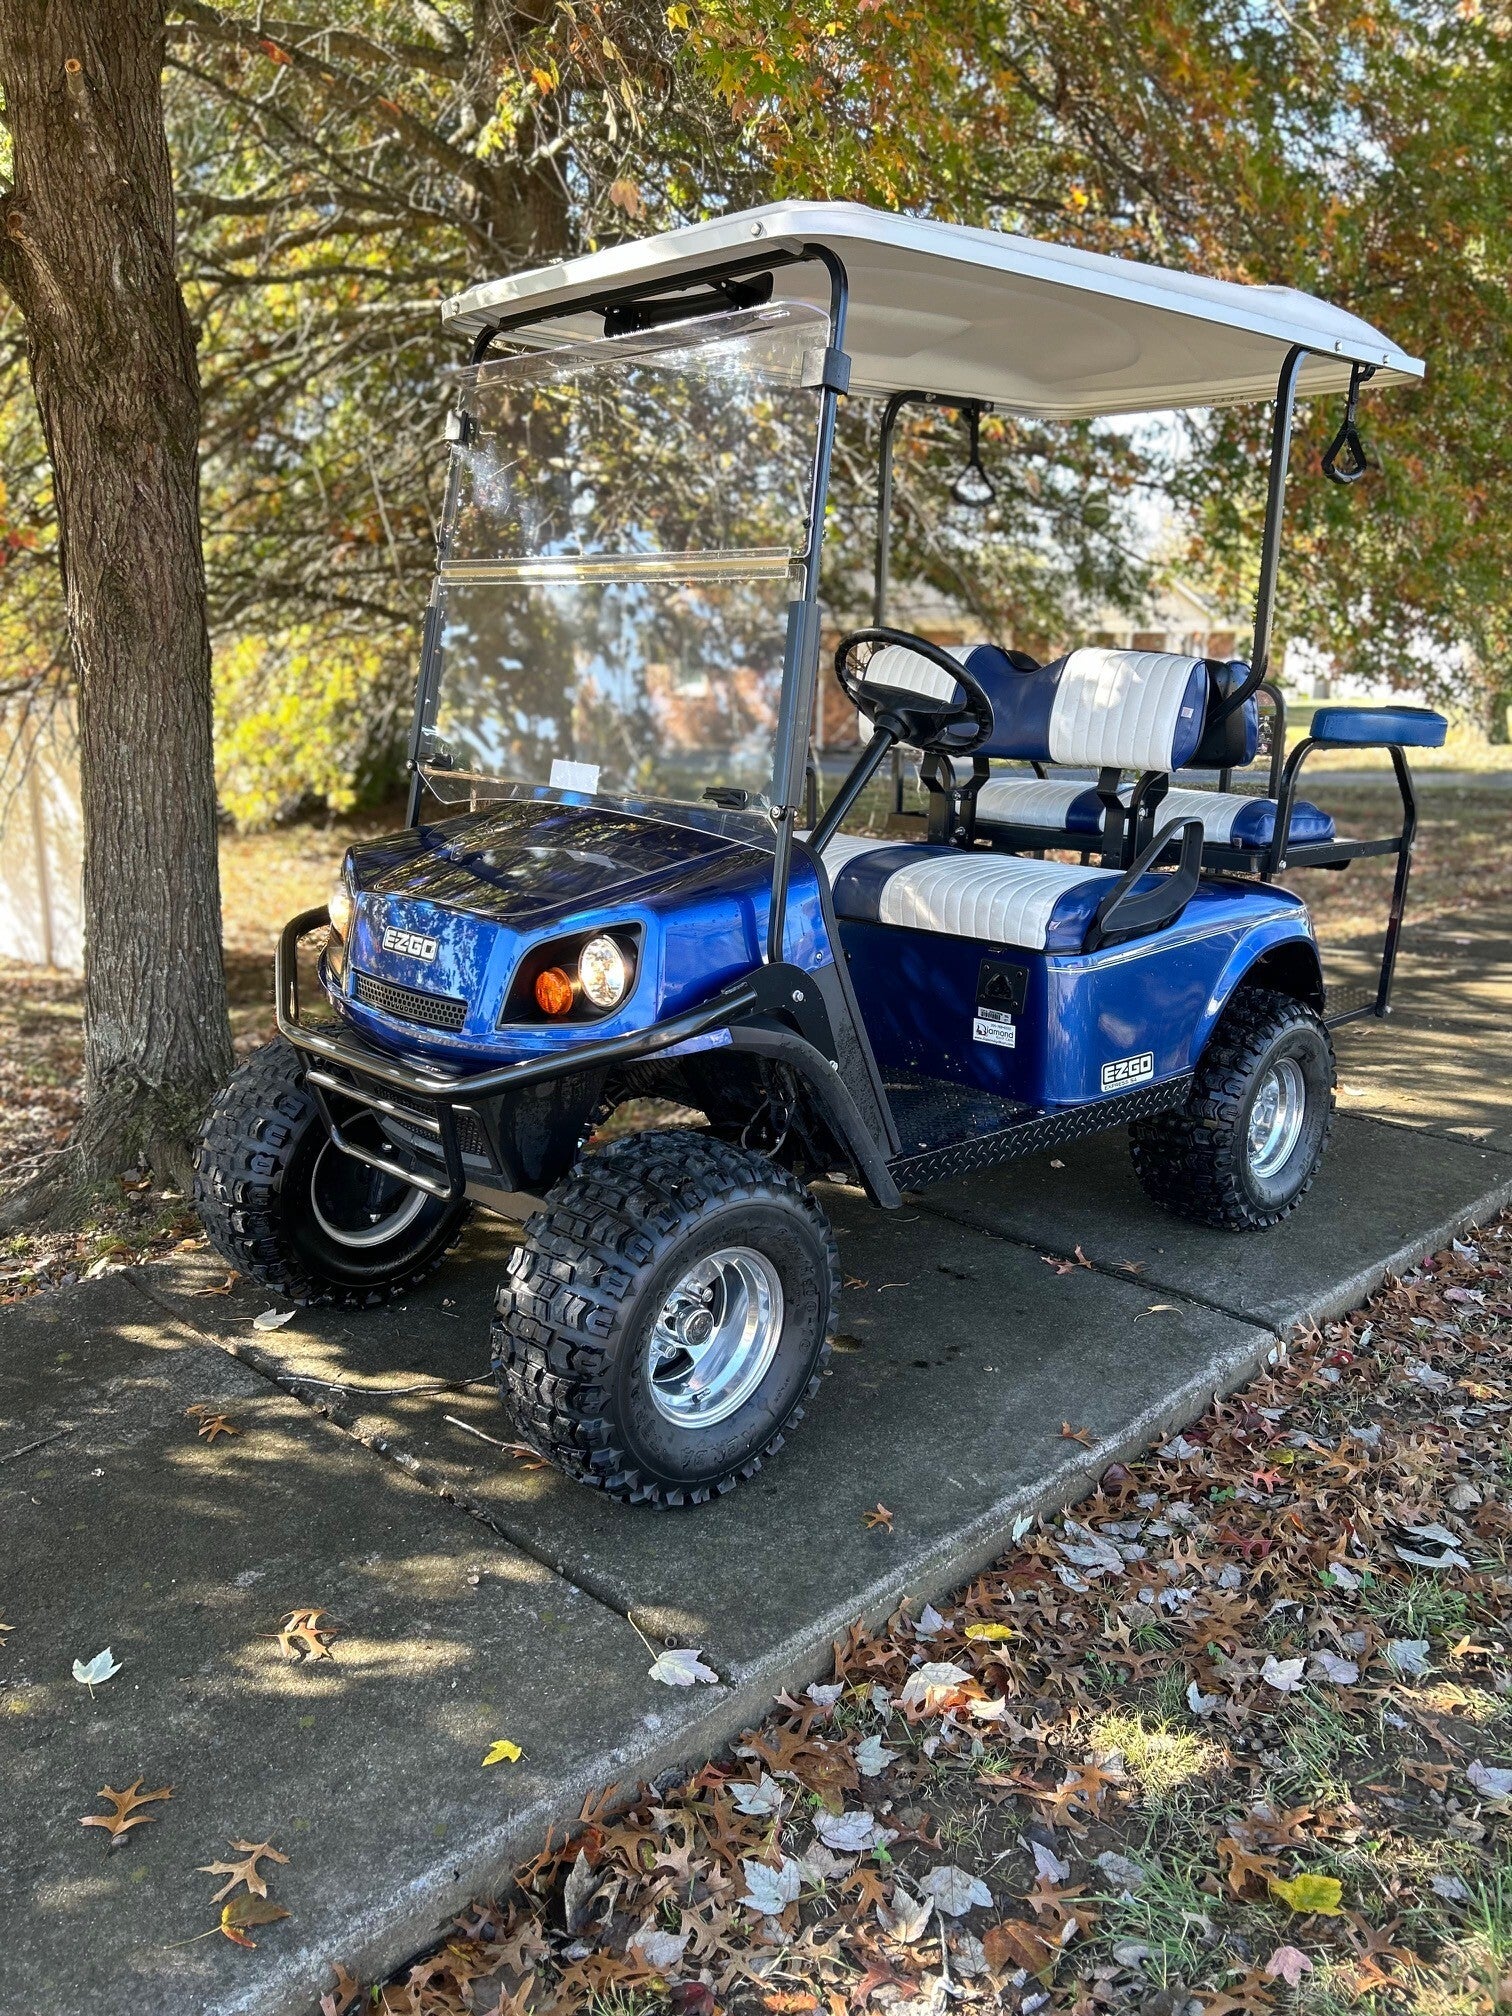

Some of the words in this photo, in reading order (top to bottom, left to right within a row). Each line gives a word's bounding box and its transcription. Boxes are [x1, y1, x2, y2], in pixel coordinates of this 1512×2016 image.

[384, 928, 437, 960] EZGO
[1104, 1055, 1152, 1083] EZGO
[1104, 1079, 1129, 1091] EXPRESS
